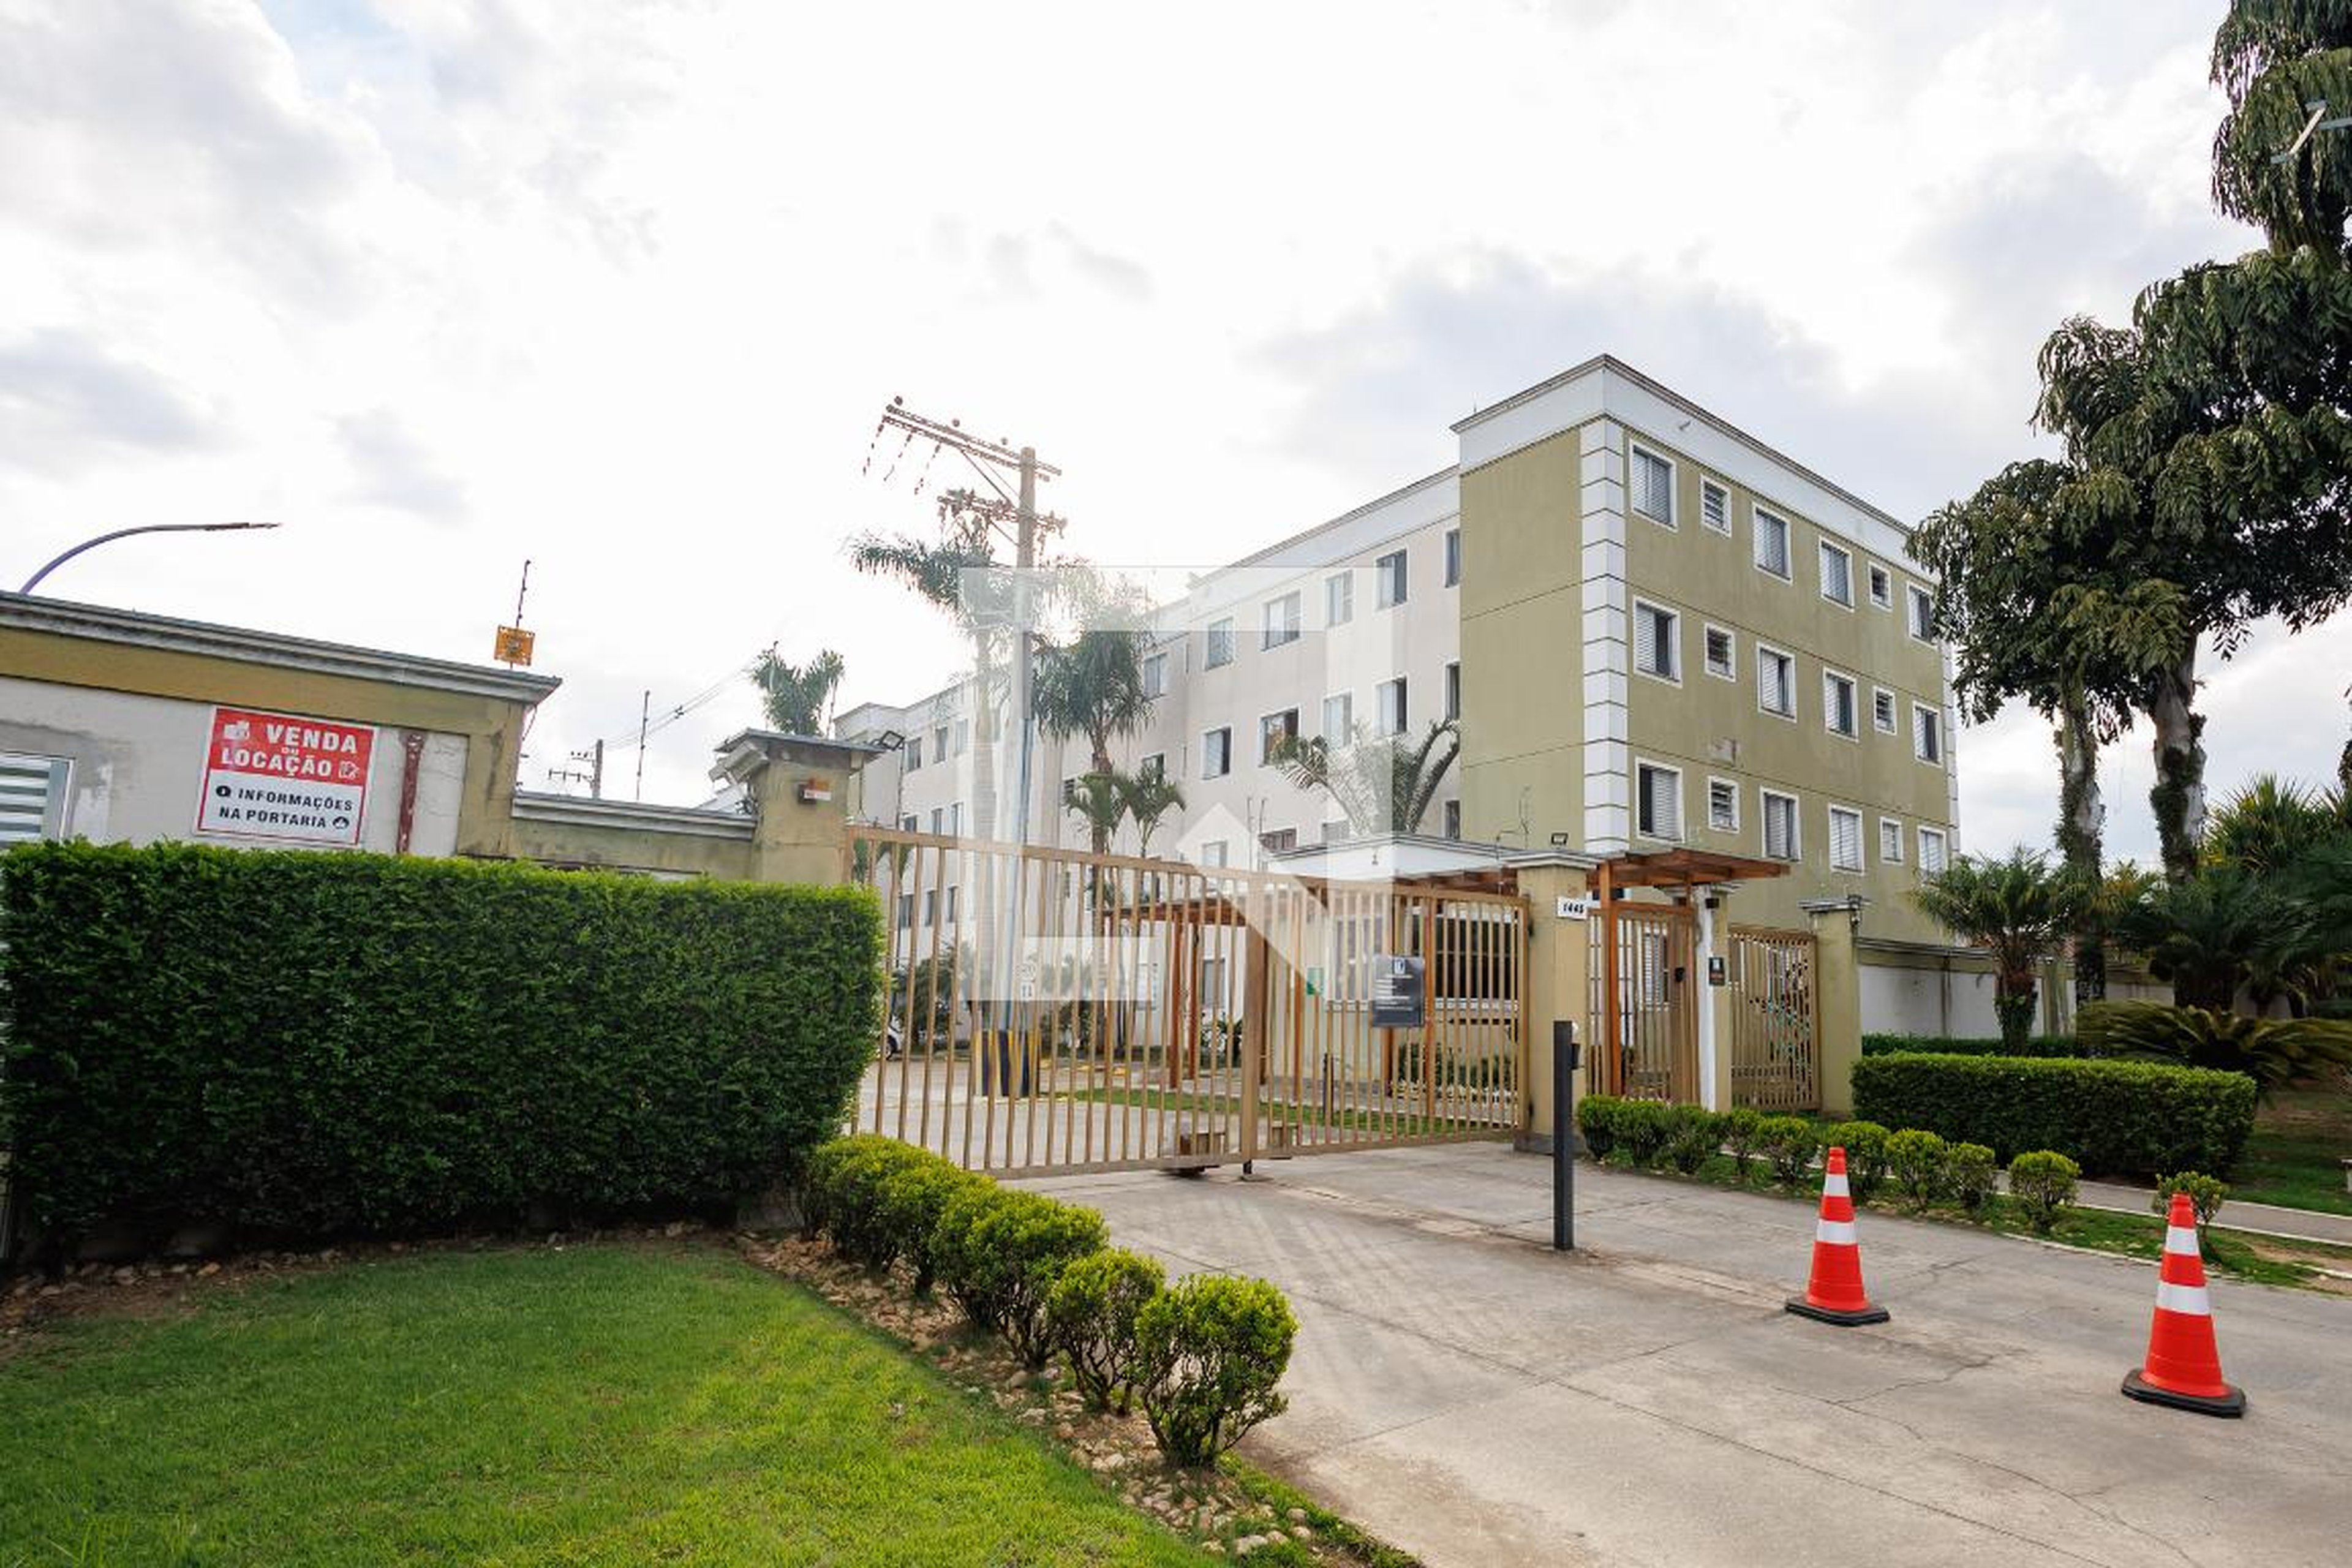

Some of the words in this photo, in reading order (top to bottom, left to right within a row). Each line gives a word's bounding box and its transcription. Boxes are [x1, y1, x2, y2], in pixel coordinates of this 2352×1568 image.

[266, 724, 357, 754] VENDA
[221, 747, 331, 777] LOCAÇÃO
[238, 788, 353, 811] INFORMAÇÕES
[219, 807, 241, 820] NA
[246, 810, 326, 827] PORTARIA
